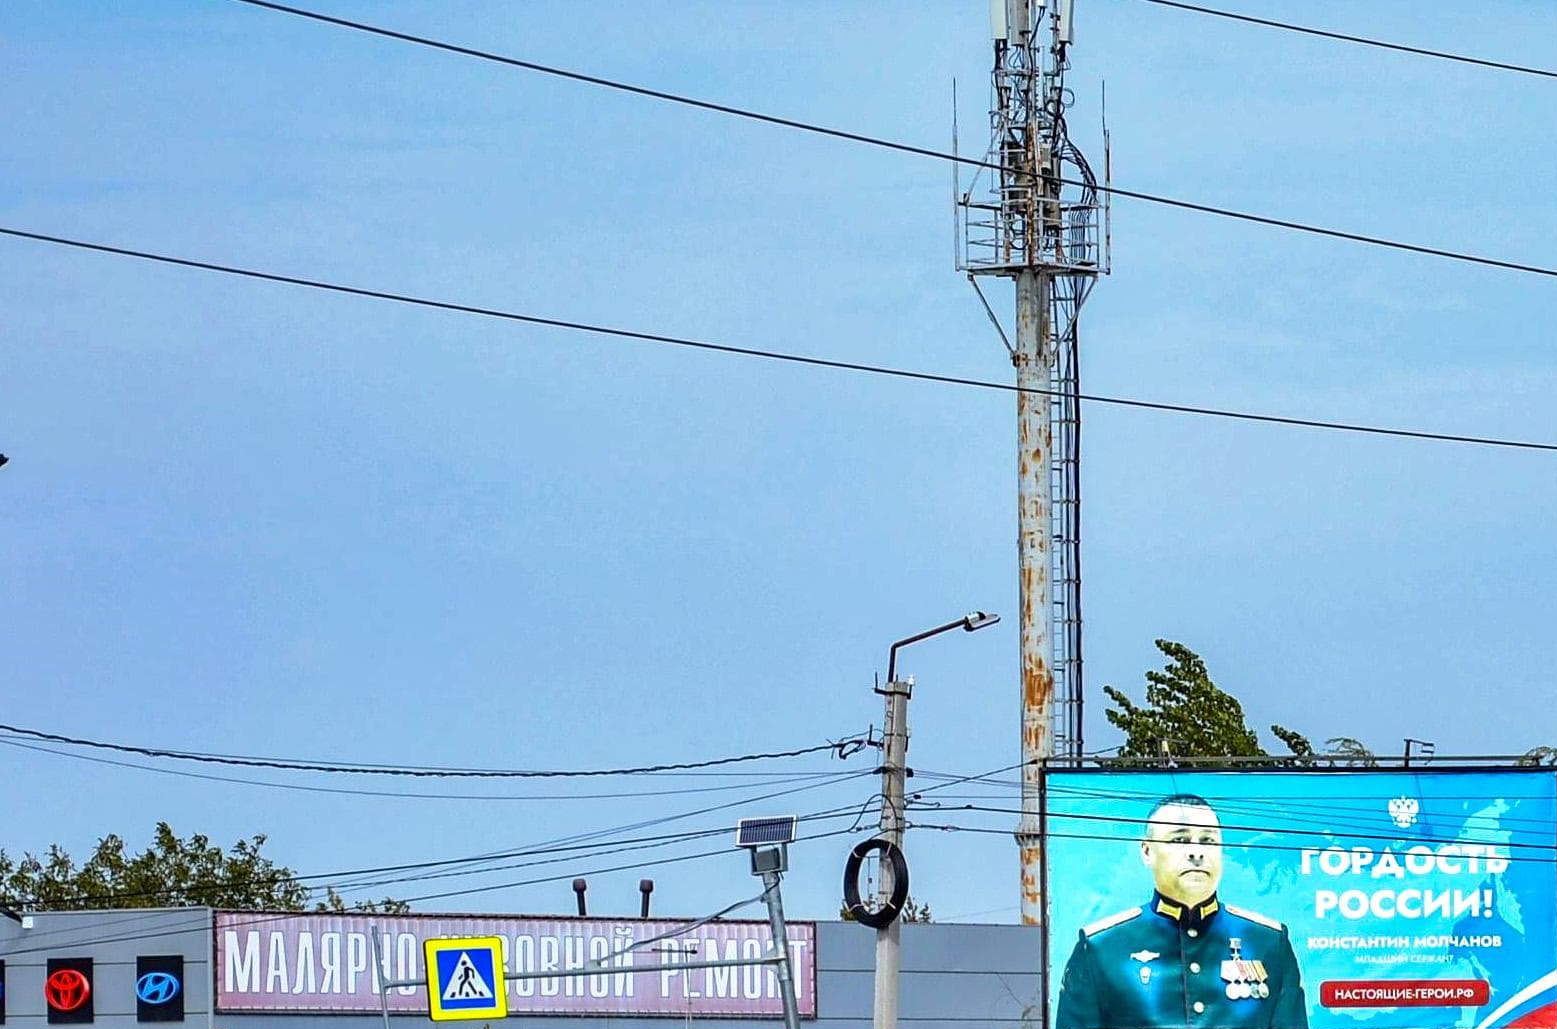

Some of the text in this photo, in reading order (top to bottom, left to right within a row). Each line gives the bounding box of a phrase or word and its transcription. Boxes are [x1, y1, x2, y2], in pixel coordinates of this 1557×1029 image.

[1300, 845, 1509, 879] ГОРДОСТЬ
[1314, 888, 1494, 919] РОССИИ!
[1307, 935, 1502, 949] КОНСТАНТИН МОЛЧАНОВ
[1335, 988, 1474, 1000] НАСТОЯЩИЕ-ГЕРОИ.РФ
